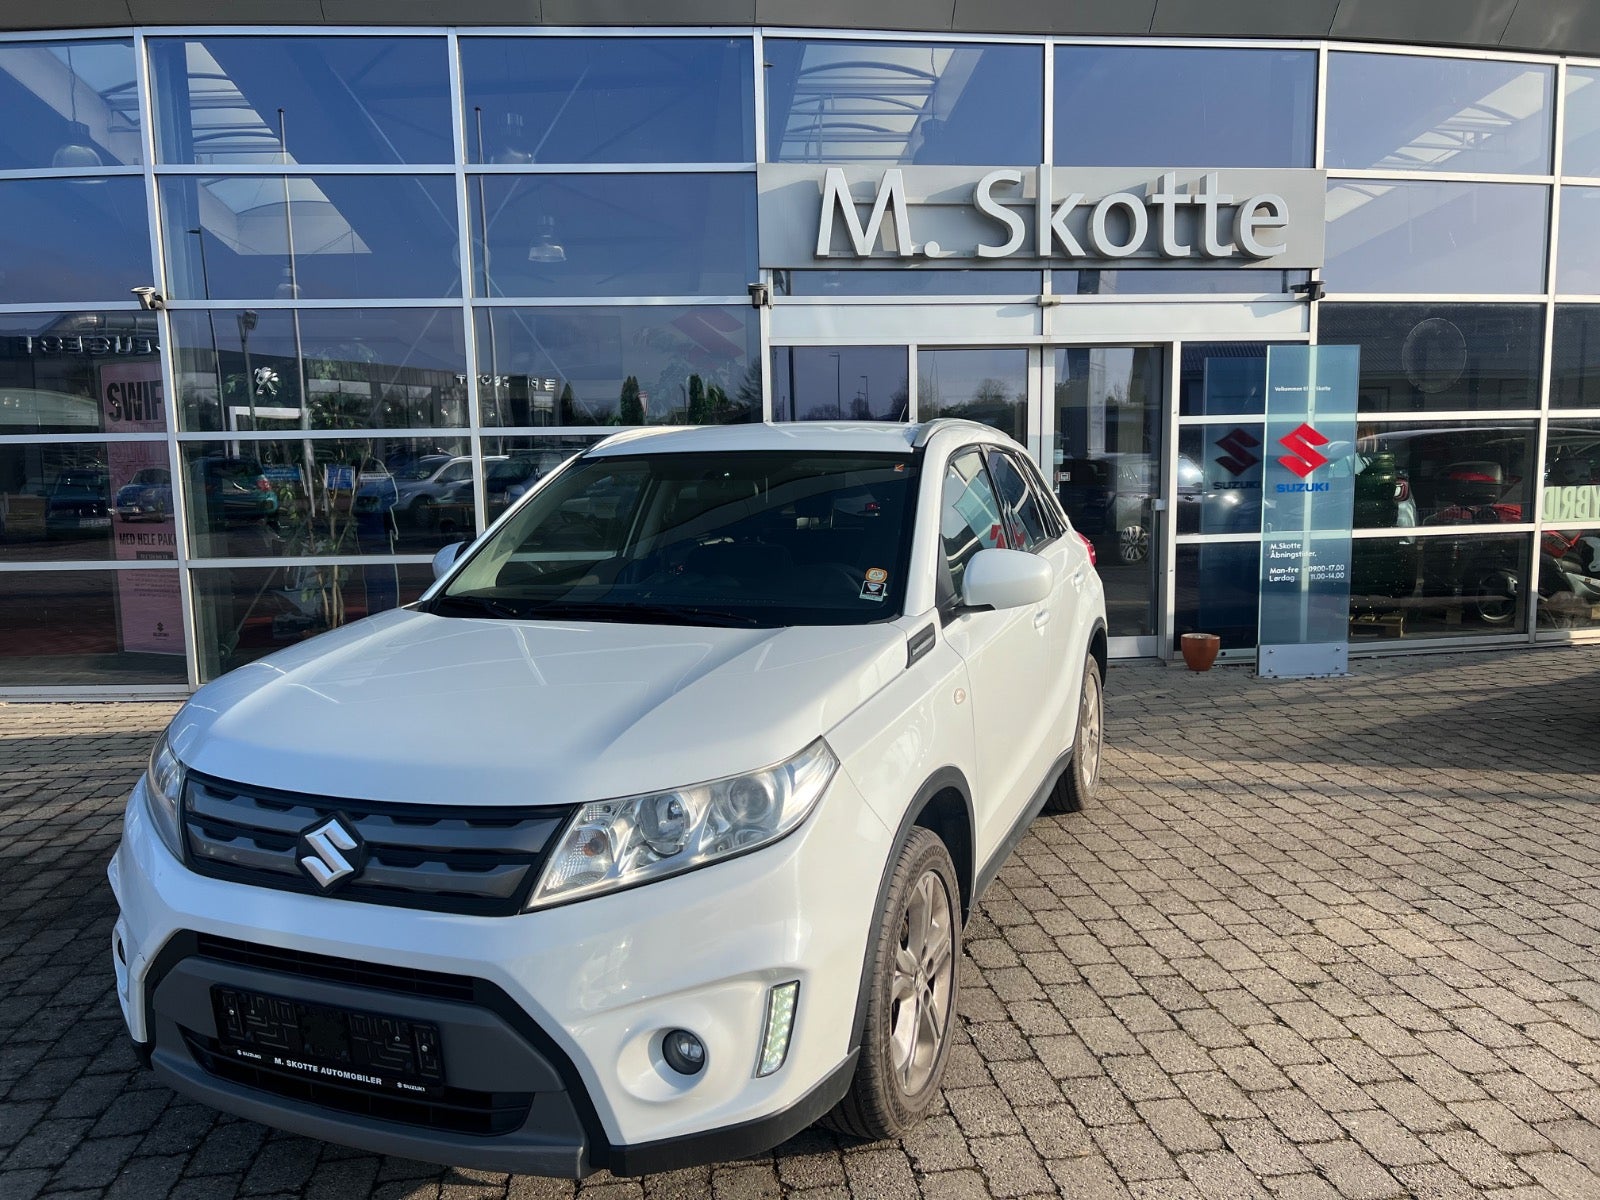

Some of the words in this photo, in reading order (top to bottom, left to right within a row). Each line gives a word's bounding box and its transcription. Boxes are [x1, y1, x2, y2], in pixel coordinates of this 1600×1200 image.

[815, 167, 942, 258] M.
[974, 164, 1289, 259] Skotte
[1213, 481, 1260, 490] SUZUKI
[1275, 482, 1329, 493] SUZUKI
[119, 532, 135, 545] MED
[137, 533, 156, 545] HELE
[242, 1051, 262, 1060] SUZUKI
[274, 1057, 284, 1066] M.
[286, 1059, 318, 1073] SKOTTE
[320, 1067, 382, 1085] AUTOMOBILER
[403, 1083, 426, 1093] SUZUKI
